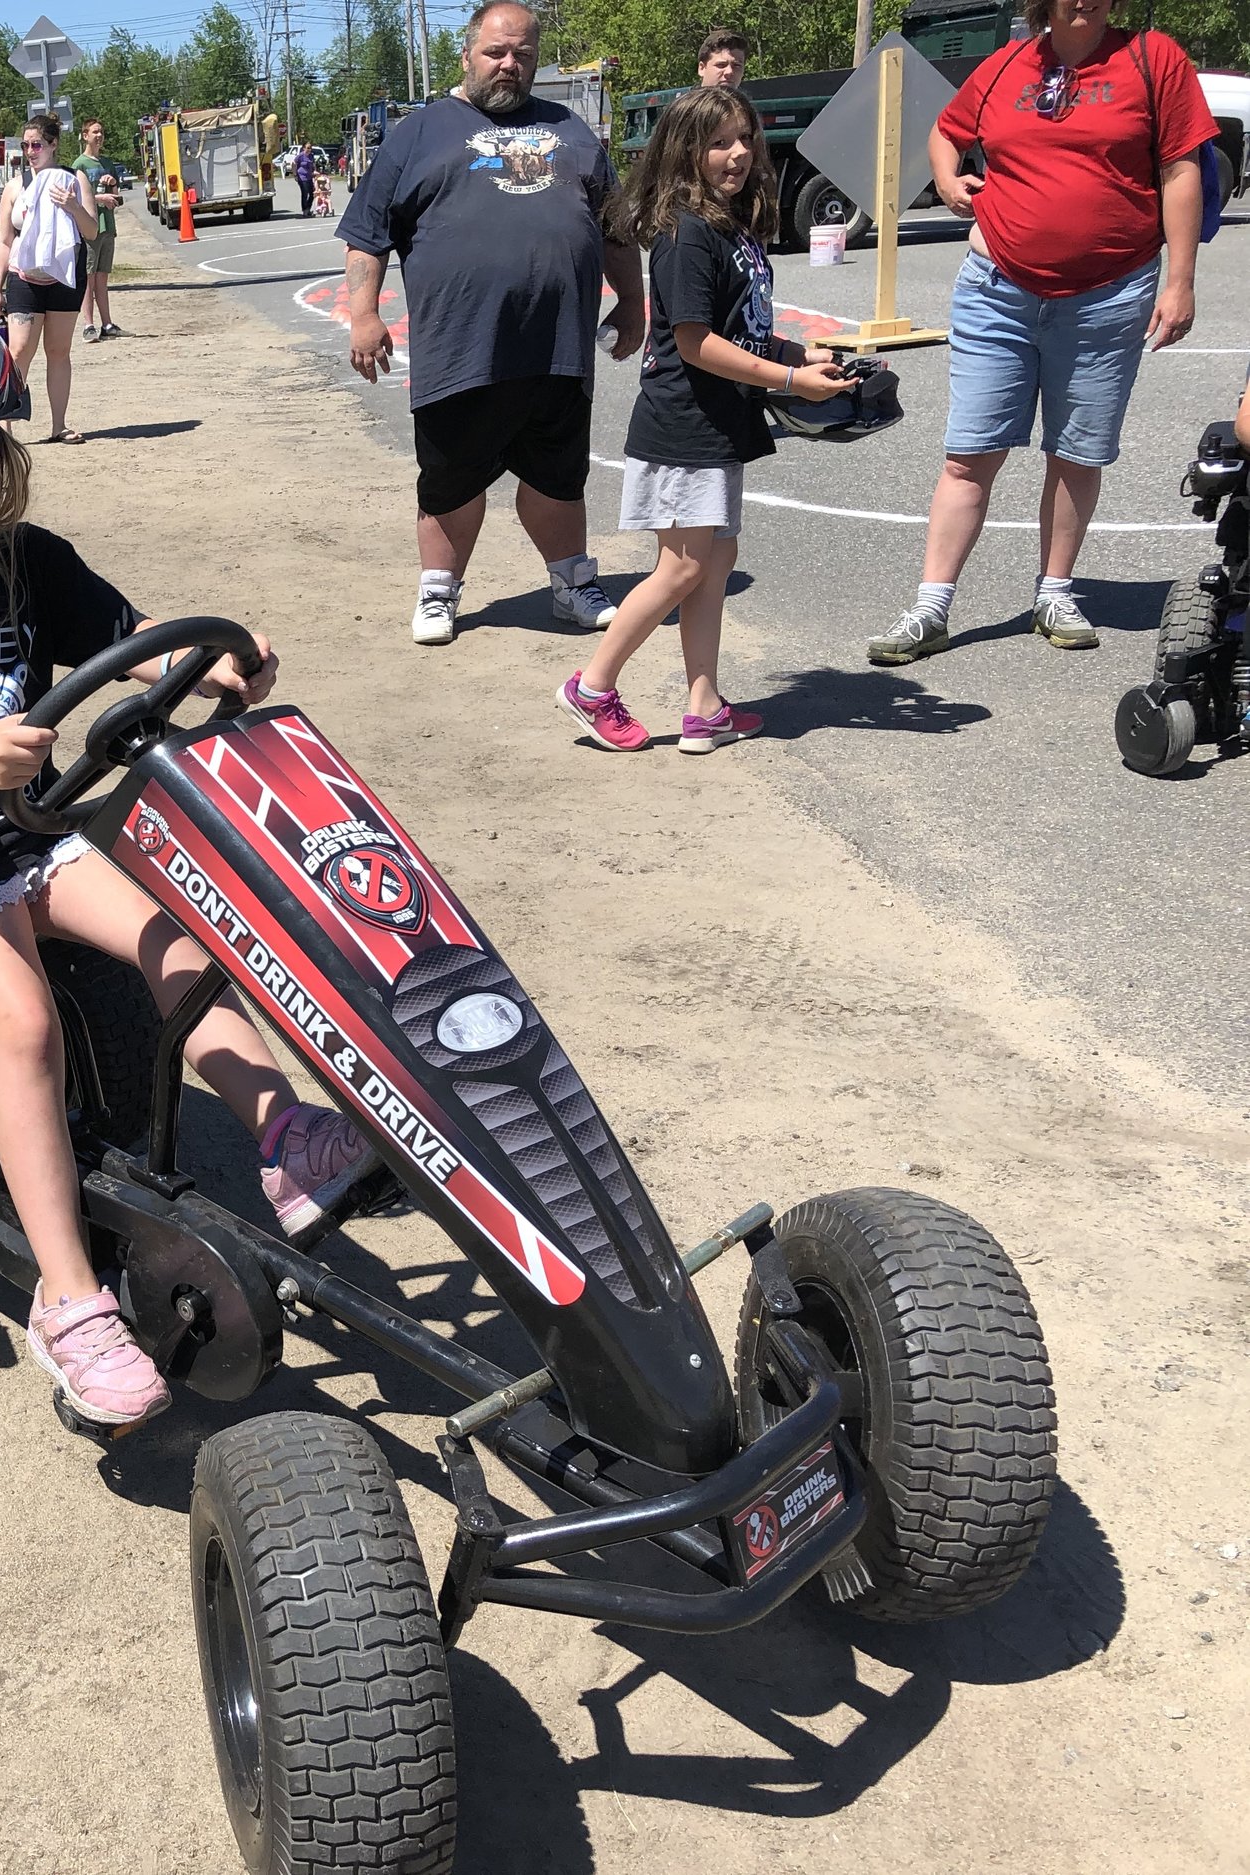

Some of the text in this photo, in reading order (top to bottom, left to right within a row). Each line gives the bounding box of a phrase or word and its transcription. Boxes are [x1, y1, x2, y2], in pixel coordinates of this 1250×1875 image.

[502, 181, 549, 193] NEW YORK
[300, 820, 374, 854] DRUNK
[303, 831, 396, 875] BUSTERS
[392, 909, 417, 924] 1995
[167, 850, 462, 1183] DON'T DRINK & DRIVE
[779, 1474, 837, 1528] BUSTERS
[783, 1467, 827, 1511] DRUNK
